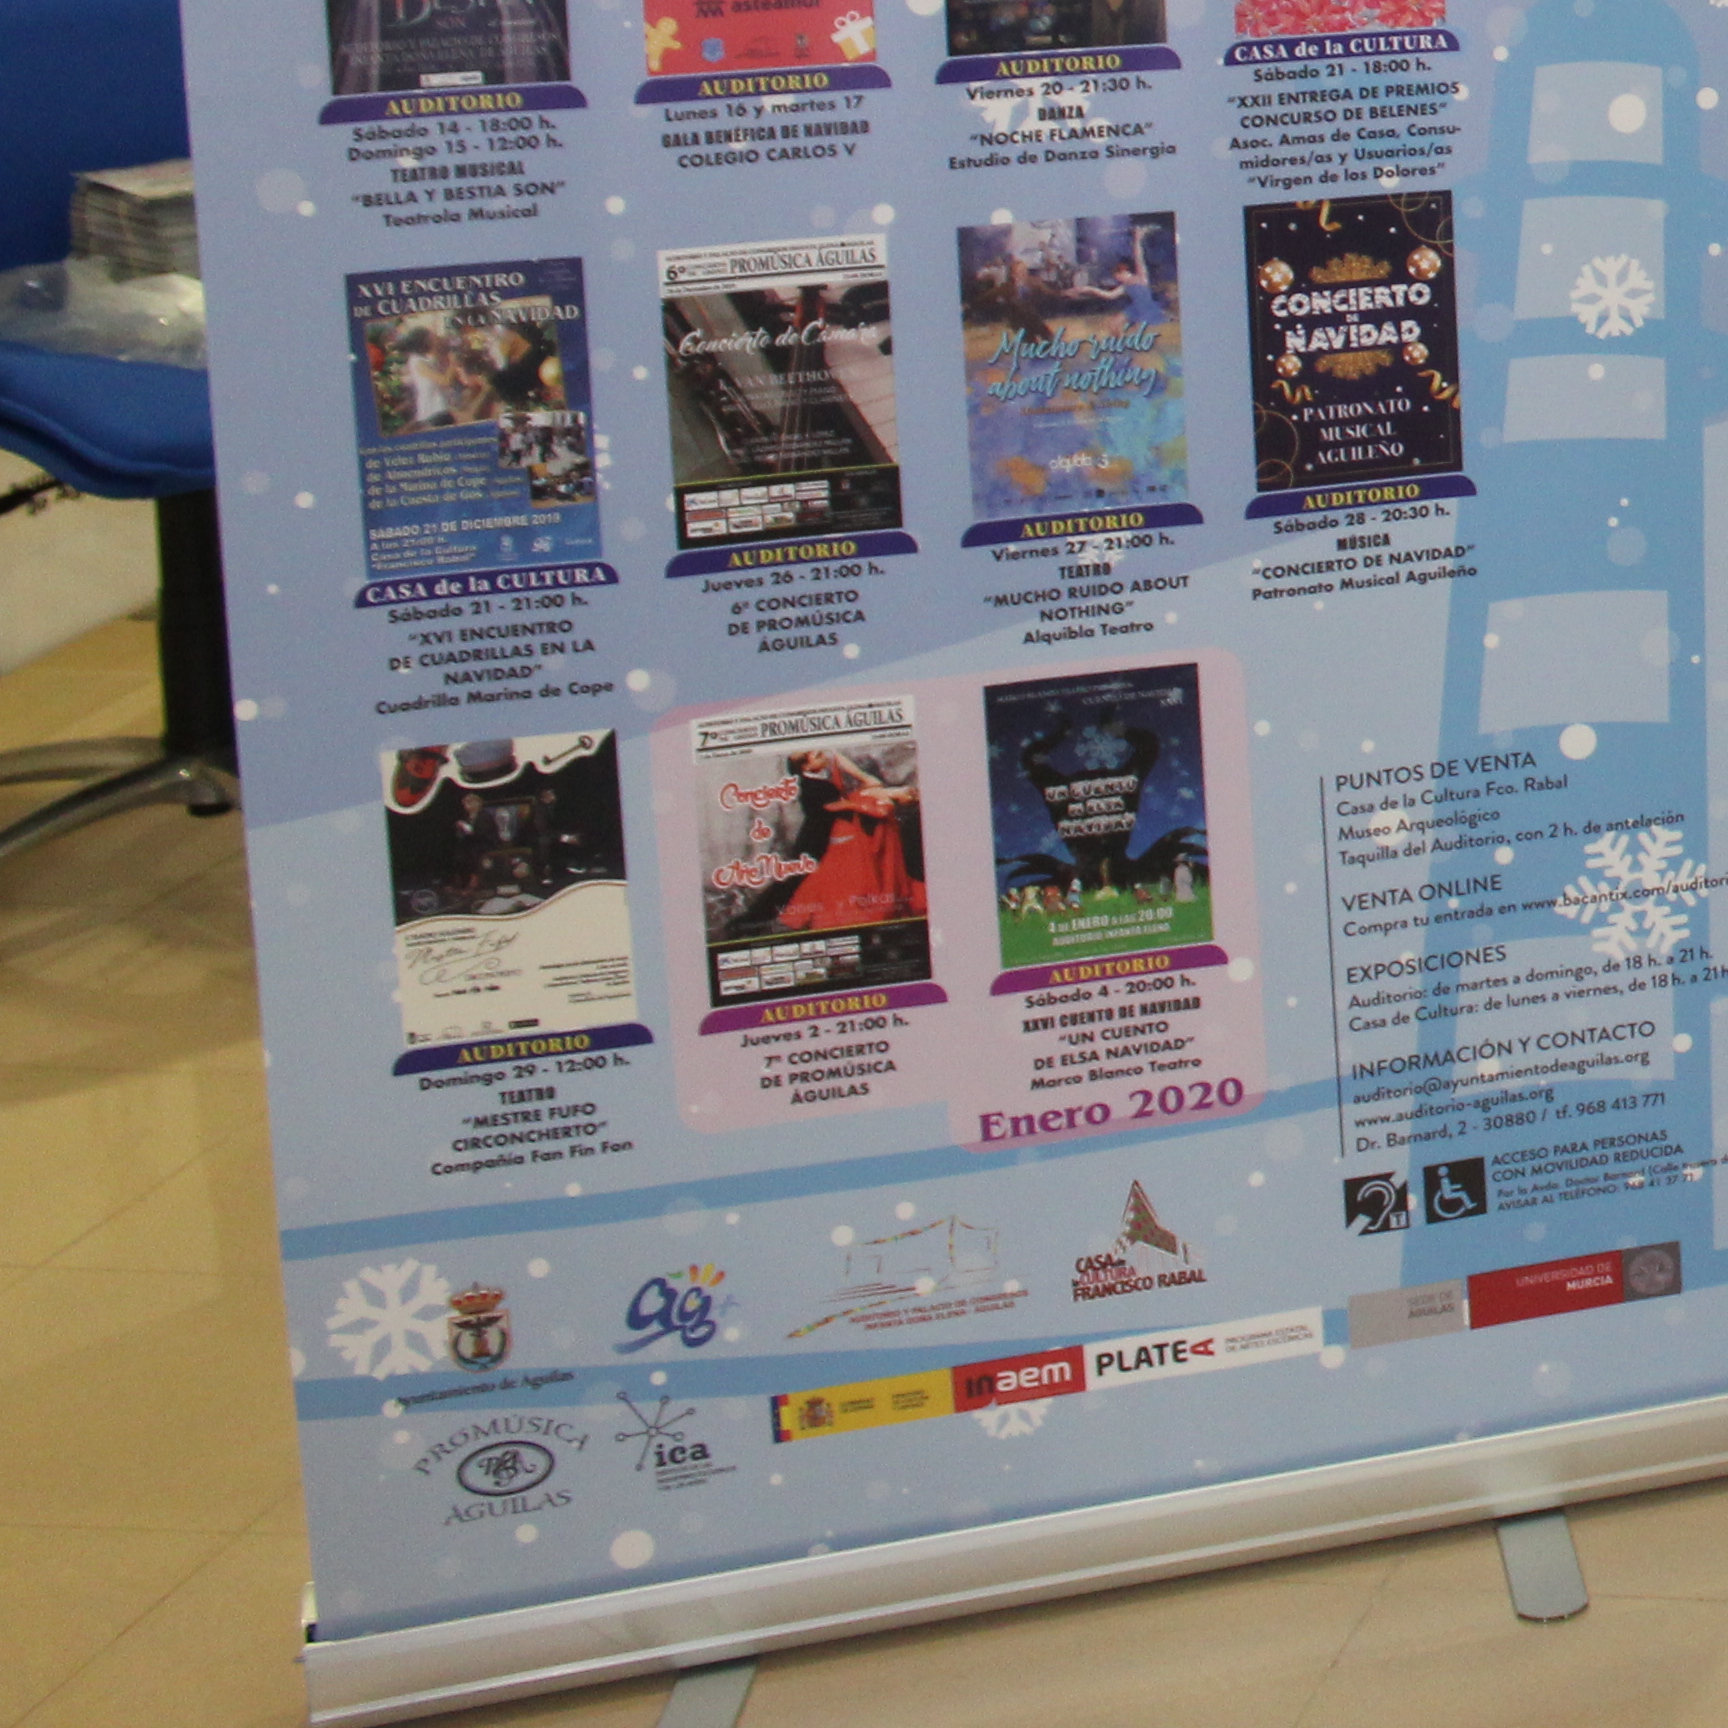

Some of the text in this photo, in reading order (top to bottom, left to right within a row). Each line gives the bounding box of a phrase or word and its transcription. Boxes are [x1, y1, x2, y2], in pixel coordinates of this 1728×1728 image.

[1234, 31, 1449, 62] CASA de la CULTURA
[995, 51, 1121, 76] AUDITORIO
[698, 73, 829, 99] AUDITORIO
[676, 142, 856, 168] COLEGIO CARLOS V
[948, 141, 1176, 170] Estudio de Danza Sinergia
[1270, 282, 1432, 318] CONCIERTO
[1284, 320, 1422, 355] NAVIDAD
[1302, 397, 1412, 422] PATRONATO
[1318, 422, 1397, 444] MUSICAL
[1315, 440, 1405, 466] AGUILEÑO
[1302, 483, 1421, 511] AUDITORIO
[1251, 564, 1477, 600] Patronato Musical Aguileño
[1334, 751, 1536, 791] PUNTOS DE VENTA
[1335, 773, 1568, 817] Casa de la Cultura Fco. Rabal
[1337, 810, 1500, 841] Museo Arqueológico
[1340, 873, 1502, 911] VENTA ONLINE
[1050, 953, 1171, 983] AUDITORIO
[1347, 944, 1507, 984] EXPOSICIONES
[1351, 1020, 1656, 1080] INFORMACIÓN Y CONTACTO
[979, 1076, 1246, 1143] Enero 2020
[1355, 1091, 1665, 1153] Dr. Barnard, 2 30880 tf. 968 413 771
[1072, 1269, 1207, 1301] FRANCISCO RABAL
[1565, 1272, 1614, 1291] MURCIA
[1096, 1337, 1216, 1377] PLATEA
[654, 1438, 711, 1469] ica
